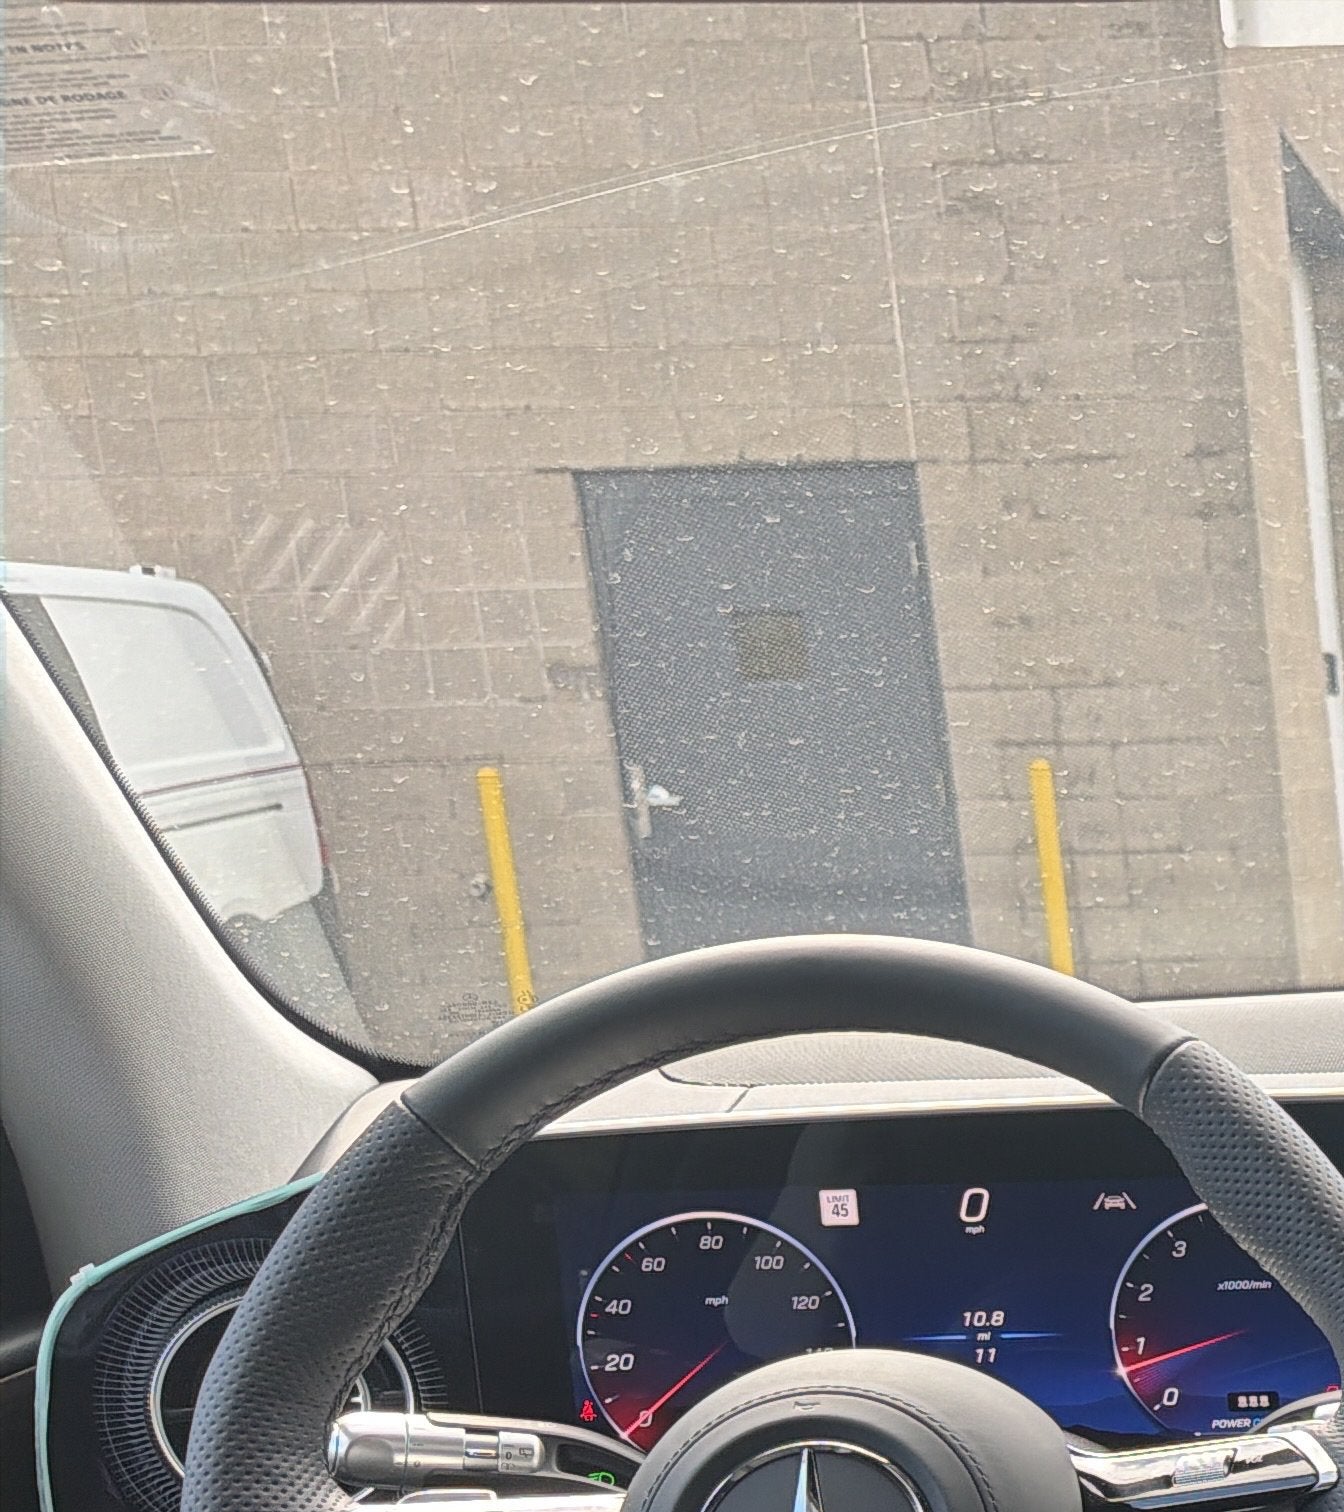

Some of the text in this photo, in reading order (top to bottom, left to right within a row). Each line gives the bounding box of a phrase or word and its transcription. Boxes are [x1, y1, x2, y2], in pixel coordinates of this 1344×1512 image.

[831, 1203, 849, 1217] 45
[959, 1187, 990, 1223] 0
[965, 1225, 985, 1235] mph
[699, 1235, 724, 1250] 80
[1171, 1240, 1188, 1258] 3
[641, 1257, 666, 1272] 60
[754, 1255, 784, 1270] 100
[1137, 1283, 1154, 1302] 2
[1216, 1279, 1273, 1292] x1000/min
[604, 1299, 632, 1315] 40
[704, 1296, 729, 1307] mph
[791, 1295, 820, 1311] 120
[963, 1310, 1005, 1327] 10.8
[976, 1331, 992, 1341] mi
[1135, 1336, 1146, 1355] 1
[604, 1353, 635, 1372] 20
[975, 1348, 997, 1364] 11
[1162, 1387, 1179, 1406] 0
[638, 1410, 653, 1428] 0
[1211, 1418, 1252, 1429] POWER
